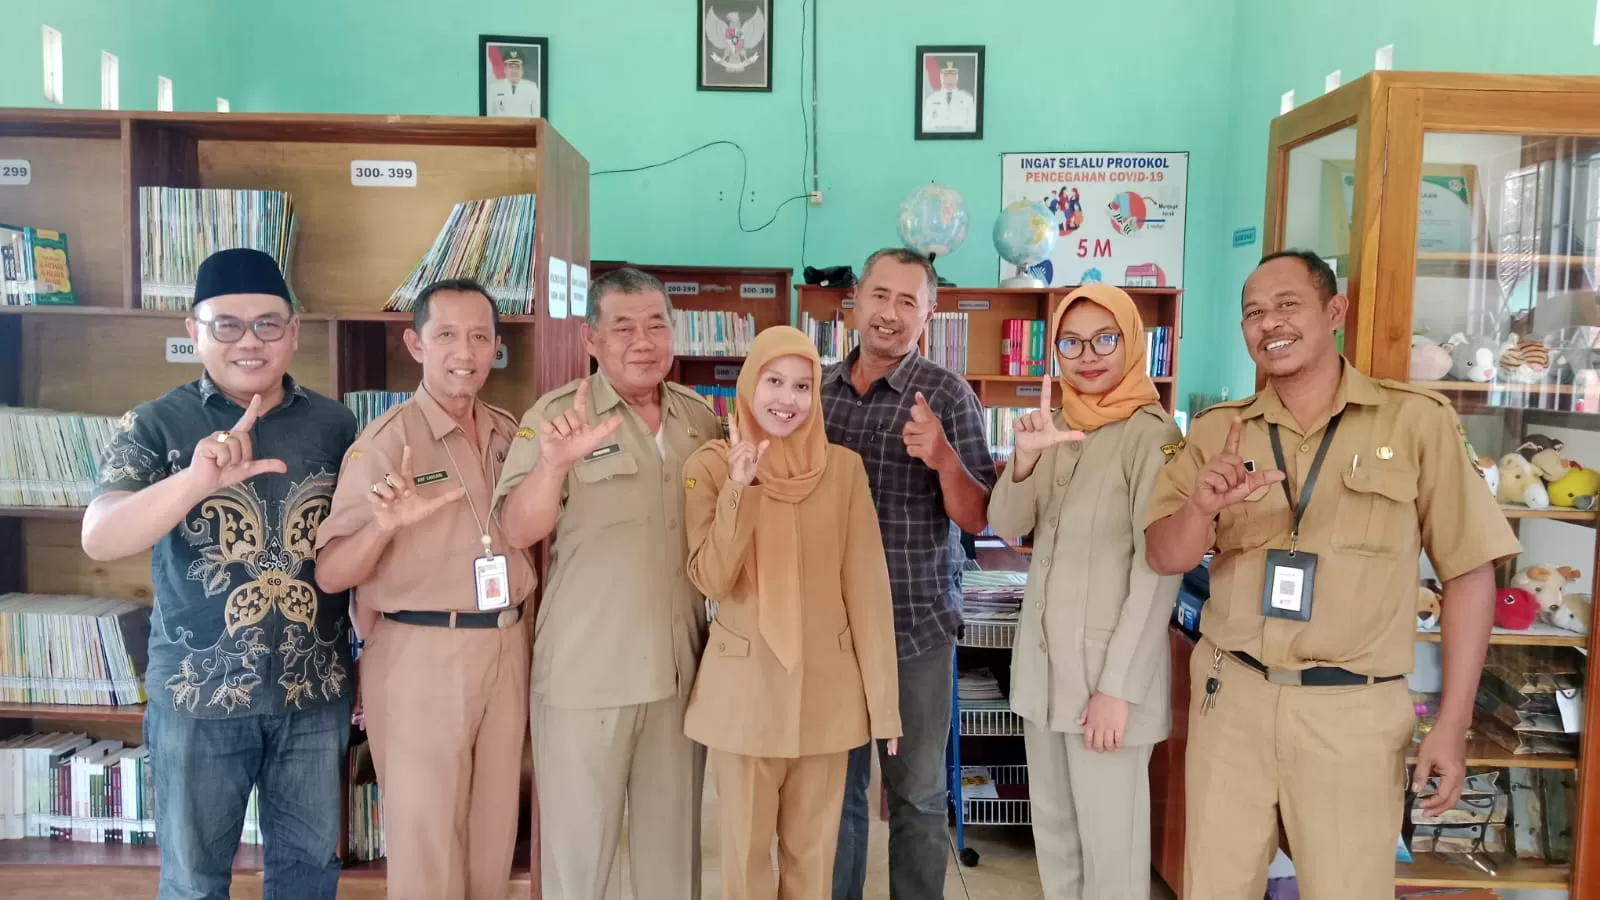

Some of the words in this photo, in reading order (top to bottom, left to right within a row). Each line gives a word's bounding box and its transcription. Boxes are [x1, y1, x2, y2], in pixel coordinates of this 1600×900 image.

[1021, 158, 1056, 168] INGAT
[1059, 158, 1103, 168] SELALU
[1107, 157, 1169, 168] PROTOKOL
[3, 166, 28, 176] 299
[388, 168, 413, 178] 399
[1026, 172, 1106, 182] PENCEGAHAN
[1109, 171, 1164, 182] COVID-19
[1077, 239, 1088, 258] 5
[1093, 238, 1112, 257] M
